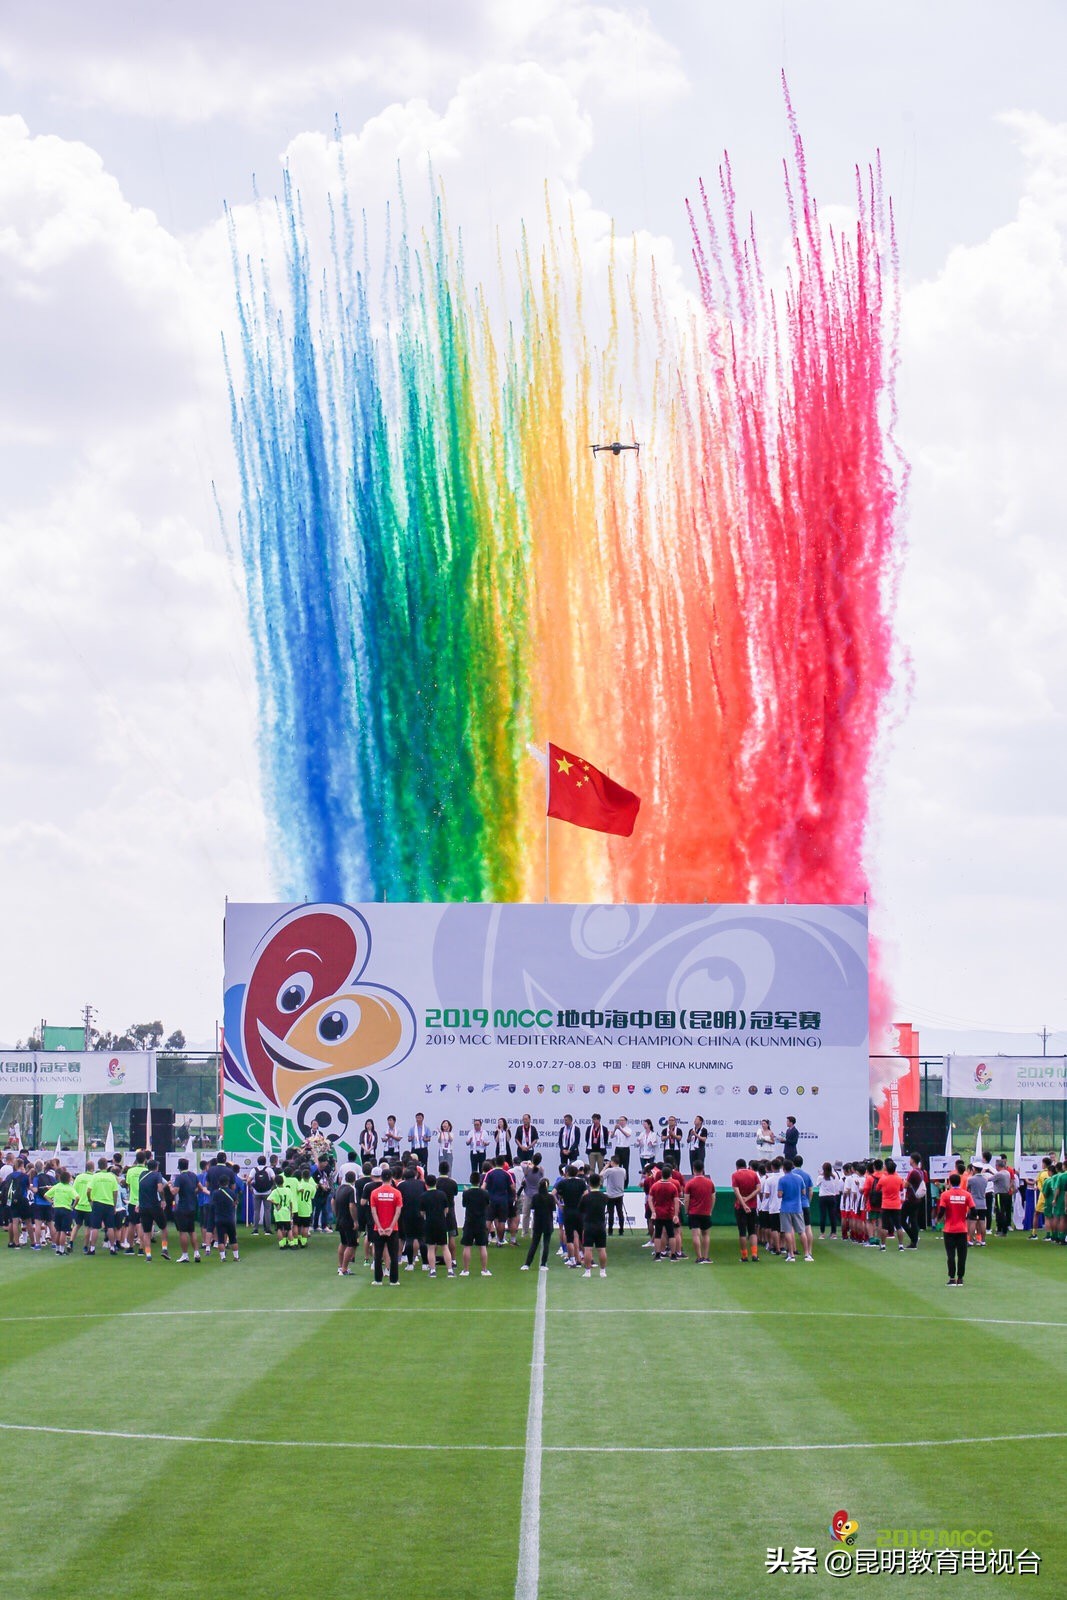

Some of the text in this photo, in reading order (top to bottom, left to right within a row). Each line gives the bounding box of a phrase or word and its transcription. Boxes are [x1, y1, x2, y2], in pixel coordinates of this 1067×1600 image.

[425, 1009, 822, 1030] 2019 MCC 地中海中国(昆明)冠军赛
[425, 1034, 822, 1049] 2019 MCC MEDITERRANEAN CHAMPION CHINA (KUNMING)
[508, 1060, 597, 1069] 2019.07.27-08.03
[656, 1061, 686, 1070] CHINA
[688, 1061, 734, 1070] KUNMING
[1017, 1066, 1054, 1078] 2019
